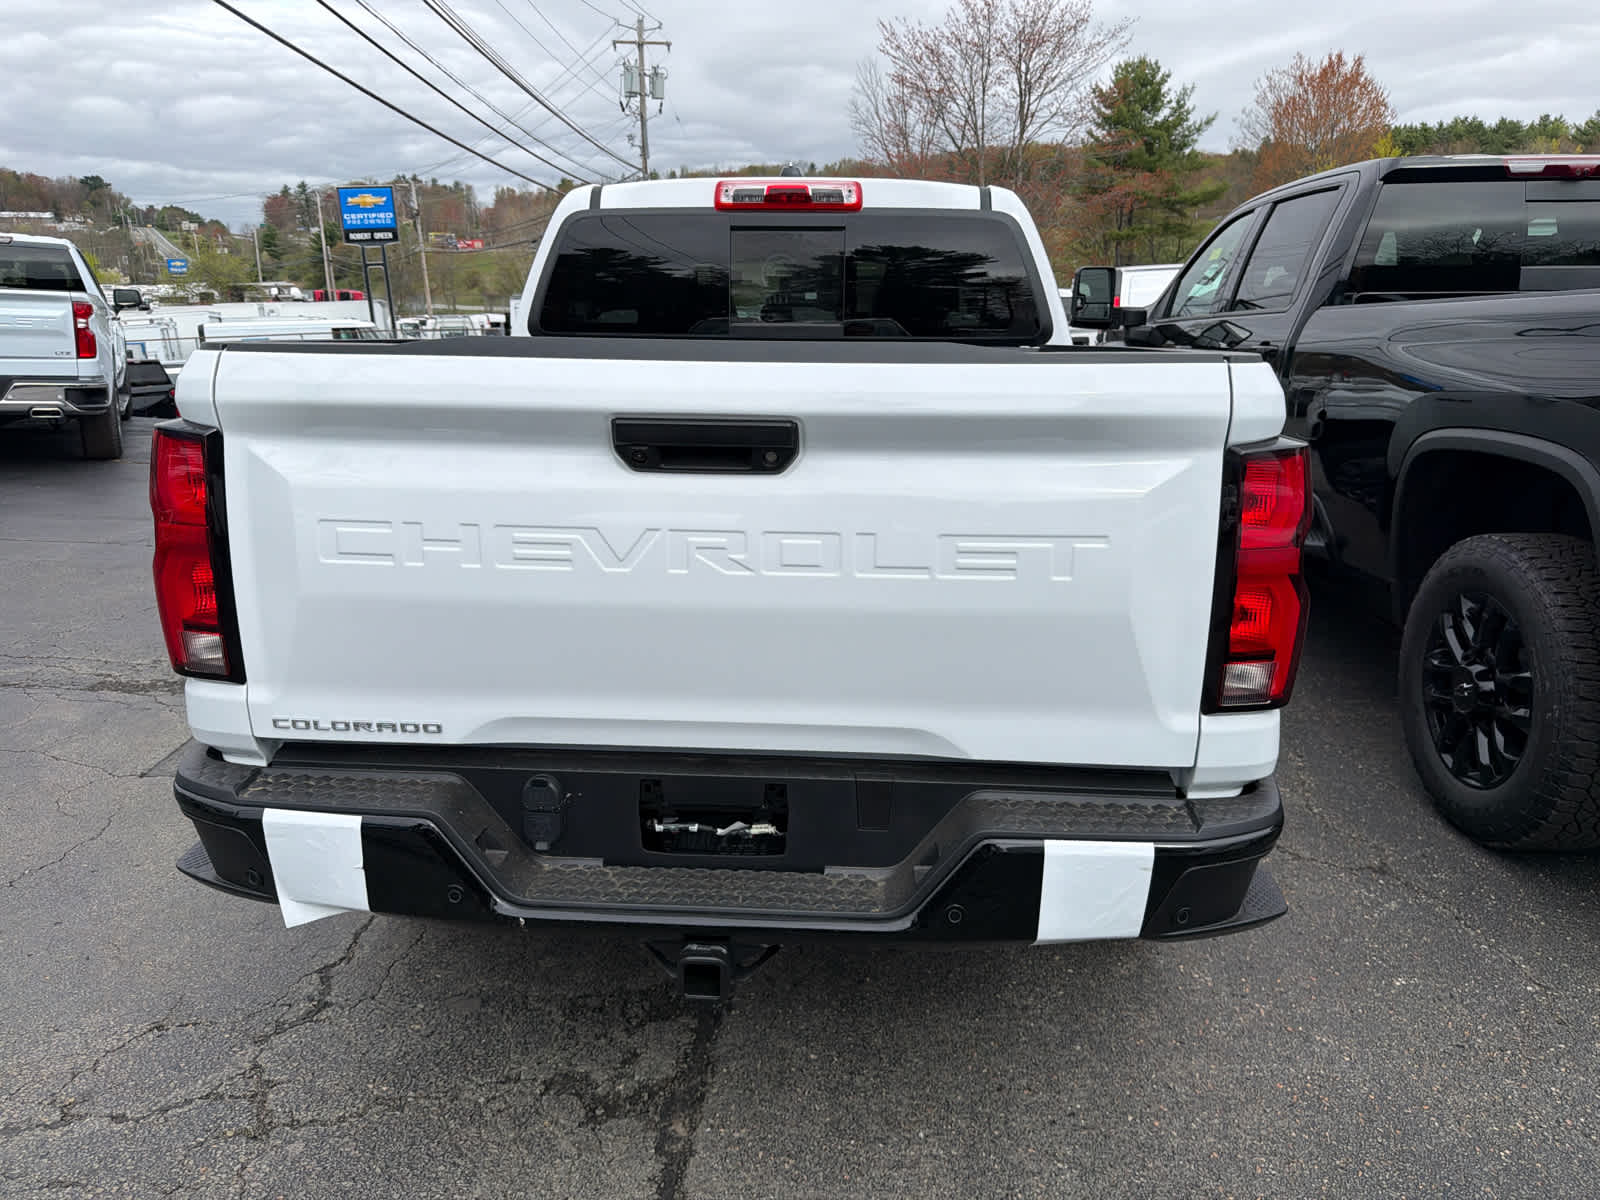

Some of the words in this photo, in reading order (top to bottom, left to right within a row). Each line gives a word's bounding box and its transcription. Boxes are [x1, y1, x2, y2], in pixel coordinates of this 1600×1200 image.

[343, 212, 393, 220] CERTIFIED
[318, 519, 1109, 582] CHEVROLET
[272, 718, 443, 734] COLORADO
